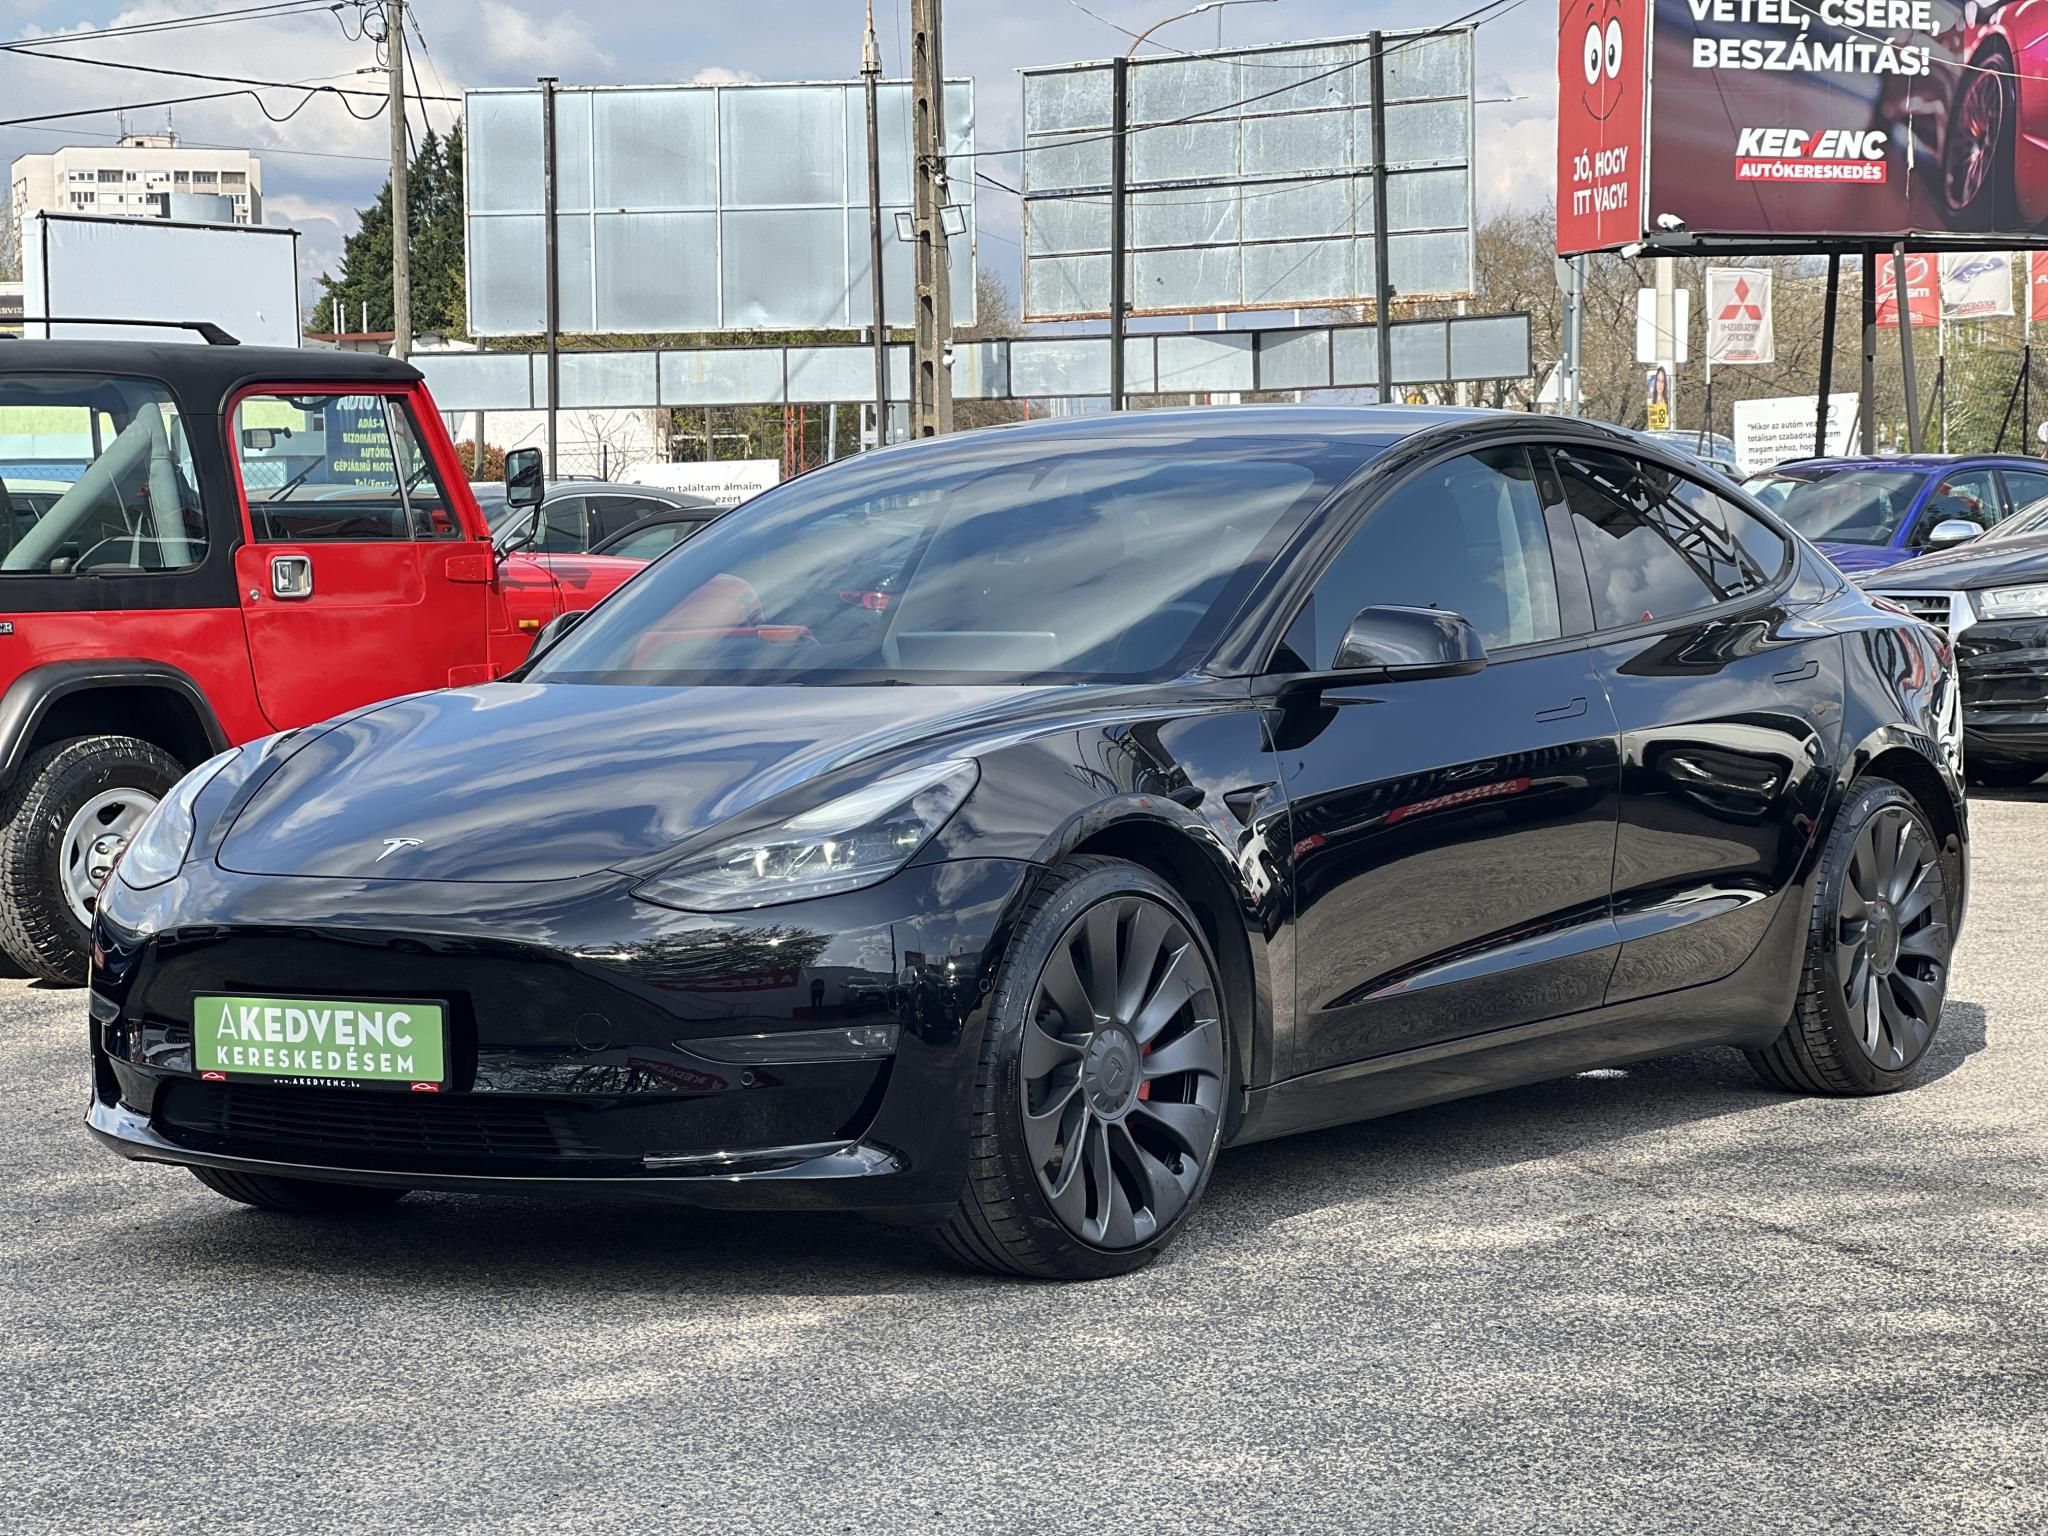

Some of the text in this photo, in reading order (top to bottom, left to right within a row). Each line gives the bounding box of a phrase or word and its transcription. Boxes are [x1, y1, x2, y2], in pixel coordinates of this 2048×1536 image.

[1820, 0, 1941, 36] CSERE,
[1692, 34, 1930, 76] BESZÁMÍTÁS!
[1573, 146, 1628, 184] JÓ, HOGY
[1739, 161, 1882, 180] AUTÓKERESKEDÉS
[1573, 182, 1628, 216] ITT VAGY!
[358, 416, 385, 428] ADÁS-V
[361, 446, 392, 458] AUTÓKO
[373, 462, 394, 472] MOTO
[723, 481, 762, 491] álmaim
[715, 494, 742, 504] ezért
[216, 1045, 414, 1073] KERESKEDÉSEM
